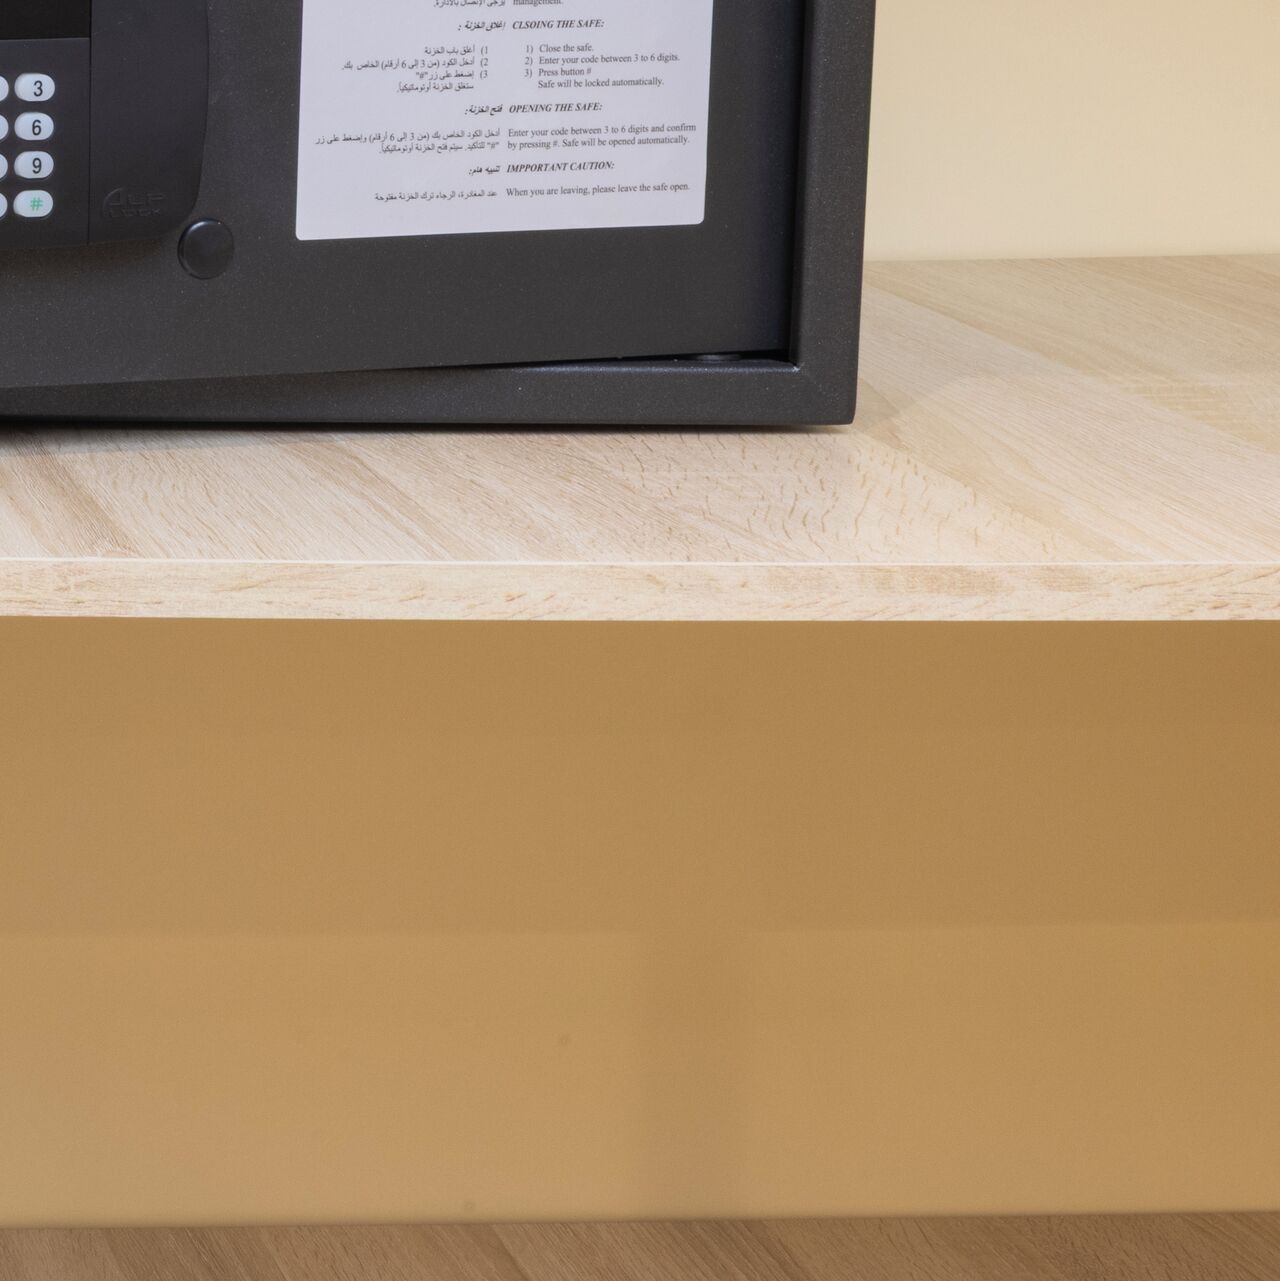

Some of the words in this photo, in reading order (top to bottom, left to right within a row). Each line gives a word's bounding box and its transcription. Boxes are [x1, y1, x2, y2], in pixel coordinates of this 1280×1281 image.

[512, 20, 553, 29] CLSOING
[557, 20, 575, 28] THE
[576, 19, 604, 27] SAFE:
[526, 44, 533, 53] 1)
[539, 43, 561, 52] Close
[563, 43, 574, 52] the
[576, 42, 593, 51] safe.
[525, 56, 533, 65] 2)
[539, 56, 559, 64] Enter
[561, 57, 579, 65] your
[581, 54, 598, 63] code
[600, 54, 631, 62] between
[634, 53, 638, 61] 3
[650, 53, 655, 61] 6
[657, 52, 680, 63] digits.
[524, 68, 532, 78] 3)
[538, 68, 558, 76] Press
[560, 67, 584, 76] button
[33, 80, 42, 96] 3
[538, 79, 554, 88] Safe
[557, 79, 571, 87] will
[574, 79, 582, 87] be
[585, 78, 609, 87] locked
[611, 76, 663, 88] automatically.
[509, 104, 551, 113] OPENING
[555, 103, 573, 111] THE
[575, 102, 602, 110] SAFE:
[32, 119, 41, 135] 6
[508, 128, 528, 137] Enter
[530, 129, 548, 137] your
[550, 127, 568, 135] code
[570, 126, 601, 135] between
[604, 125, 608, 133] 3
[620, 125, 625, 133] 6
[627, 124, 648, 135] digits
[650, 123, 664, 132] and
[666, 122, 696, 132] confirm
[507, 140, 517, 150] by
[519, 141, 550, 150] pressing
[562, 138, 579, 147] Safe
[581, 138, 595, 146] will
[597, 137, 606, 145] be
[608, 136, 635, 146] opened
[637, 134, 689, 146] automatically.
[32, 157, 41, 174] 9
[506, 162, 568, 172] IMPPORTANT
[569, 161, 614, 170] CAUTION:
[506, 187, 528, 196] When
[530, 189, 544, 197] you
[560, 185, 590, 196] leaving,
[592, 185, 615, 195] please
[617, 184, 637, 192] leave
[639, 183, 650, 191] the
[652, 182, 668, 191] safe
[669, 184, 689, 192] open.
